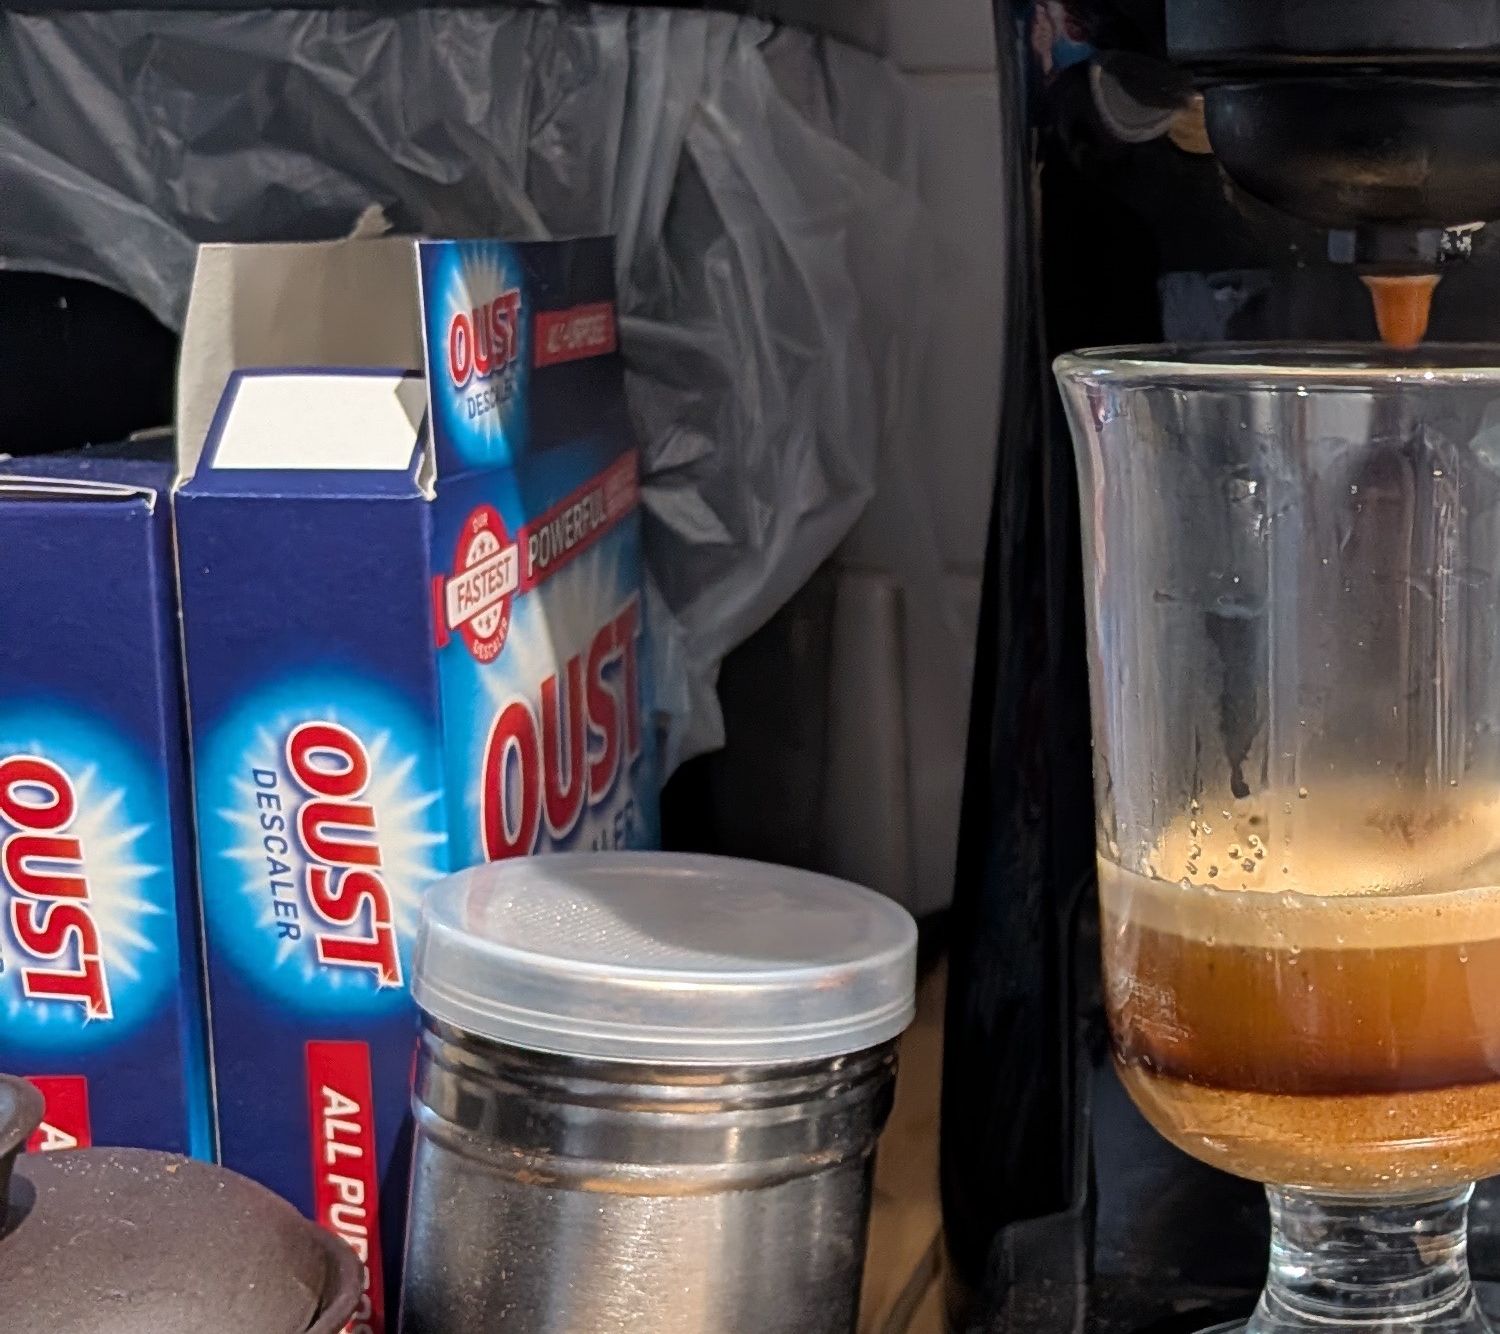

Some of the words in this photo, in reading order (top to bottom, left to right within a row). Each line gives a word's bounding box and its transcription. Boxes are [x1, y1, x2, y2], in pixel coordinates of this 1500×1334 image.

[448, 290, 521, 387] OUST
[457, 556, 513, 613] FASTEST
[482, 599, 641, 862] OUST
[0, 755, 113, 1020] OUST
[252, 768, 301, 941] DESCALER
[285, 721, 403, 987] OUST
[321, 1084, 362, 1164] ALL
